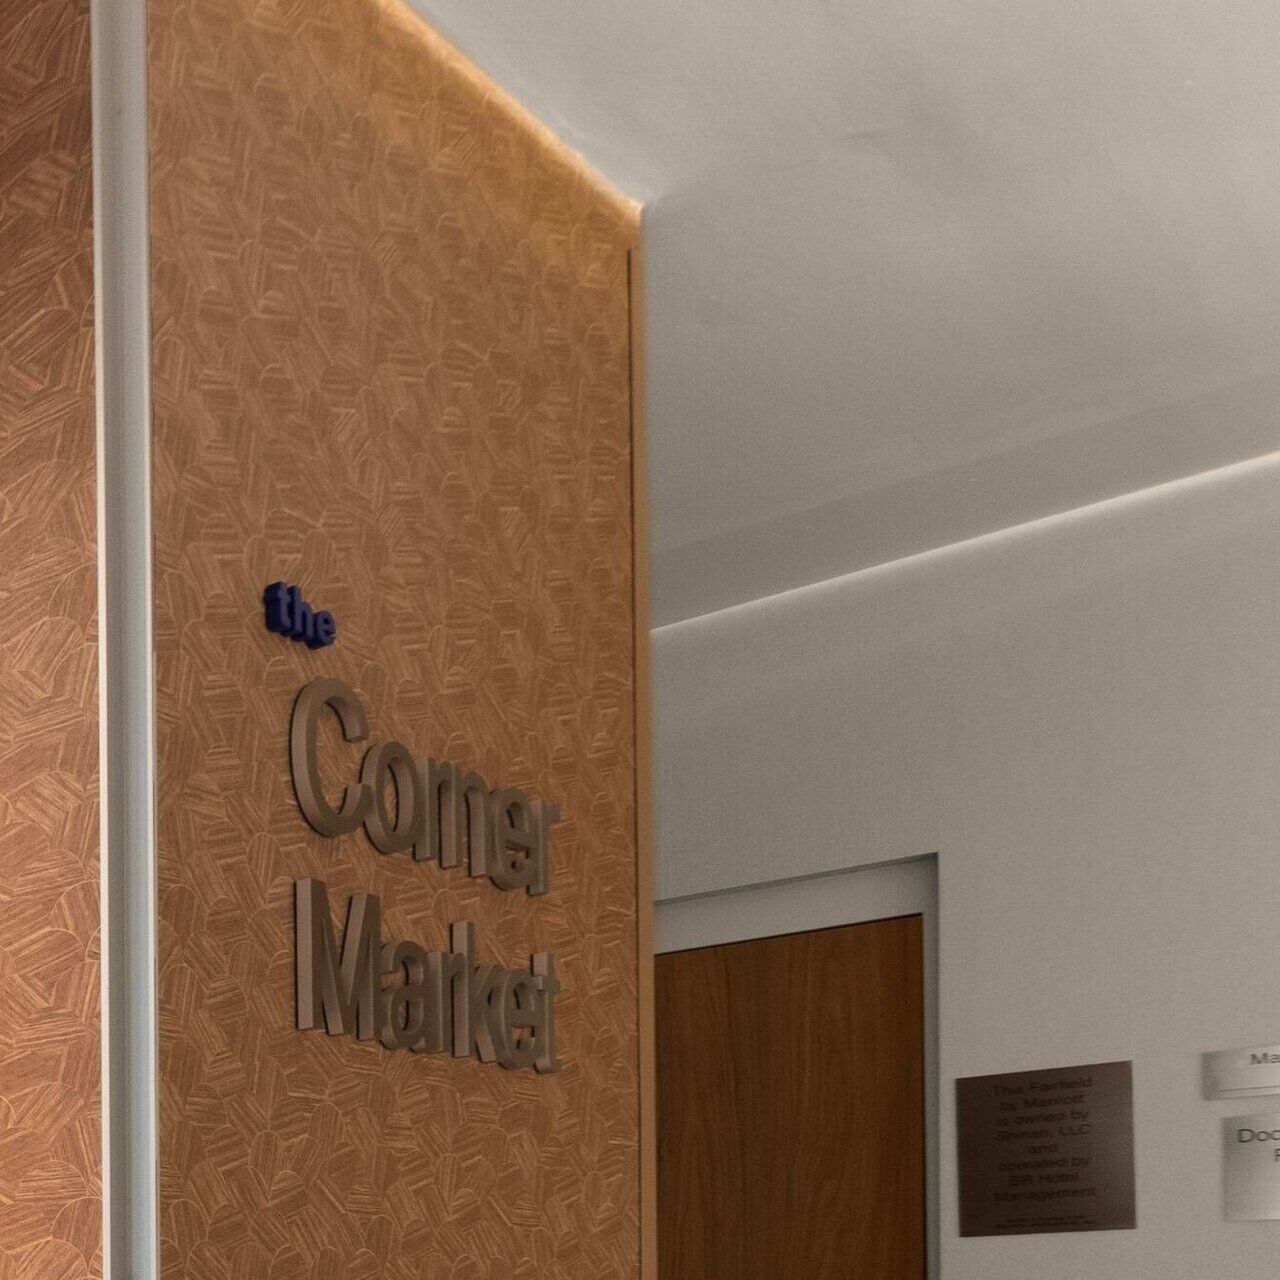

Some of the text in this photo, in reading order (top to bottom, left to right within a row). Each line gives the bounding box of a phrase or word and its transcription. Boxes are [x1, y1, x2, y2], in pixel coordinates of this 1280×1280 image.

[264, 581, 337, 650] the
[290, 677, 563, 896] Corner
[293, 878, 561, 1075] Market
[1070, 1110, 1091, 1121] by
[1058, 1123, 1092, 1136] LLC
[1028, 1143, 1058, 1154] and
[997, 1156, 1092, 1172] operated by
[1038, 1171, 1080, 1184] Hotel
[994, 1186, 1097, 1202] Management
